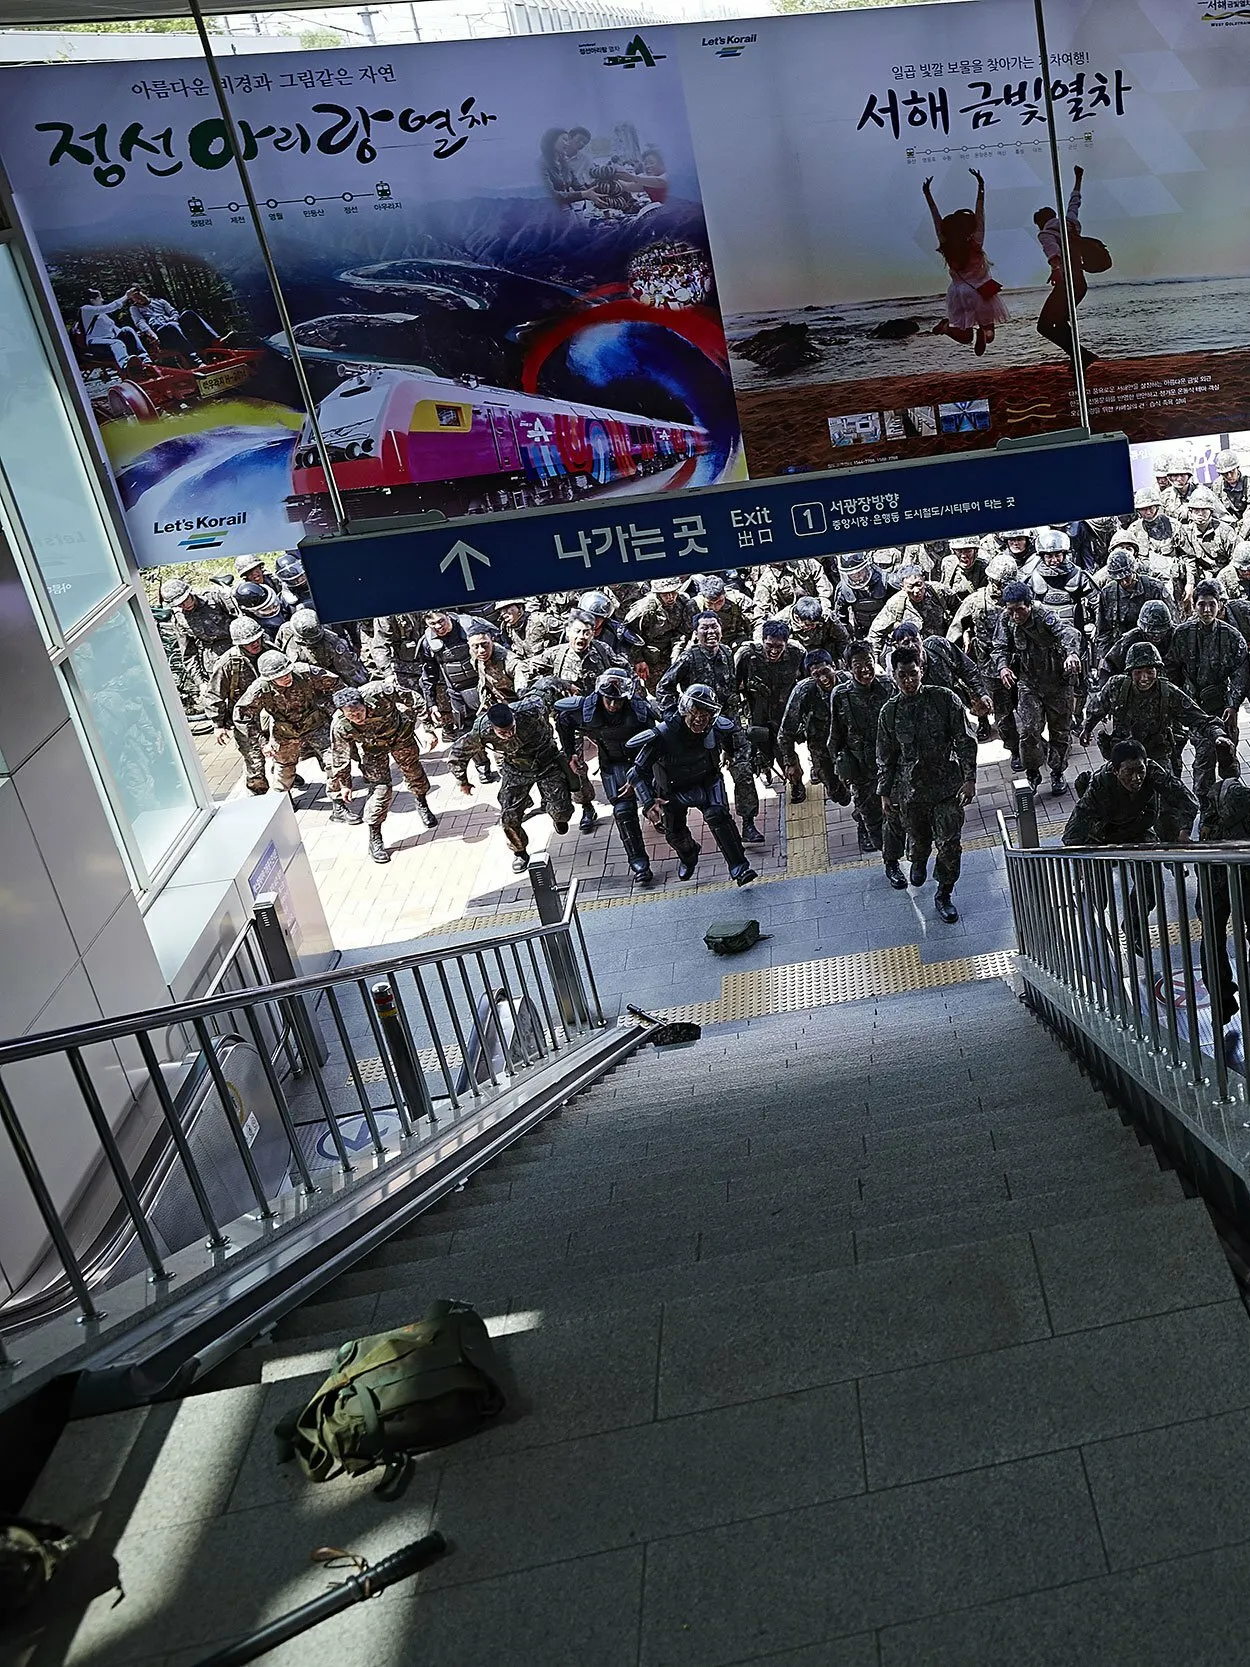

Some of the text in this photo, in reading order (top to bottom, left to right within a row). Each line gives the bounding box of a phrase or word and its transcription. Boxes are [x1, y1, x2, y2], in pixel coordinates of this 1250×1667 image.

[702, 33, 757, 46] Let's Korail
[891, 51, 1090, 80] 일곱 빛깔 보물을 찾아가는 차여행!
[131, 77, 210, 100] 아름다운
[279, 67, 353, 90] 그림같은
[358, 63, 397, 84] 자연
[856, 86, 950, 140] 서해
[829, 492, 900, 516] 서광장방향
[904, 501, 981, 520] 도시철도/시티투어
[984, 498, 1002, 510] 타는
[1005, 496, 1016, 508] 곳
[153, 511, 247, 535] Let's Korail
[730, 506, 773, 528] Exit
[802, 508, 815, 530] 1
[553, 514, 709, 568] 나가는 곳
[737, 528, 773, 549] 出口
